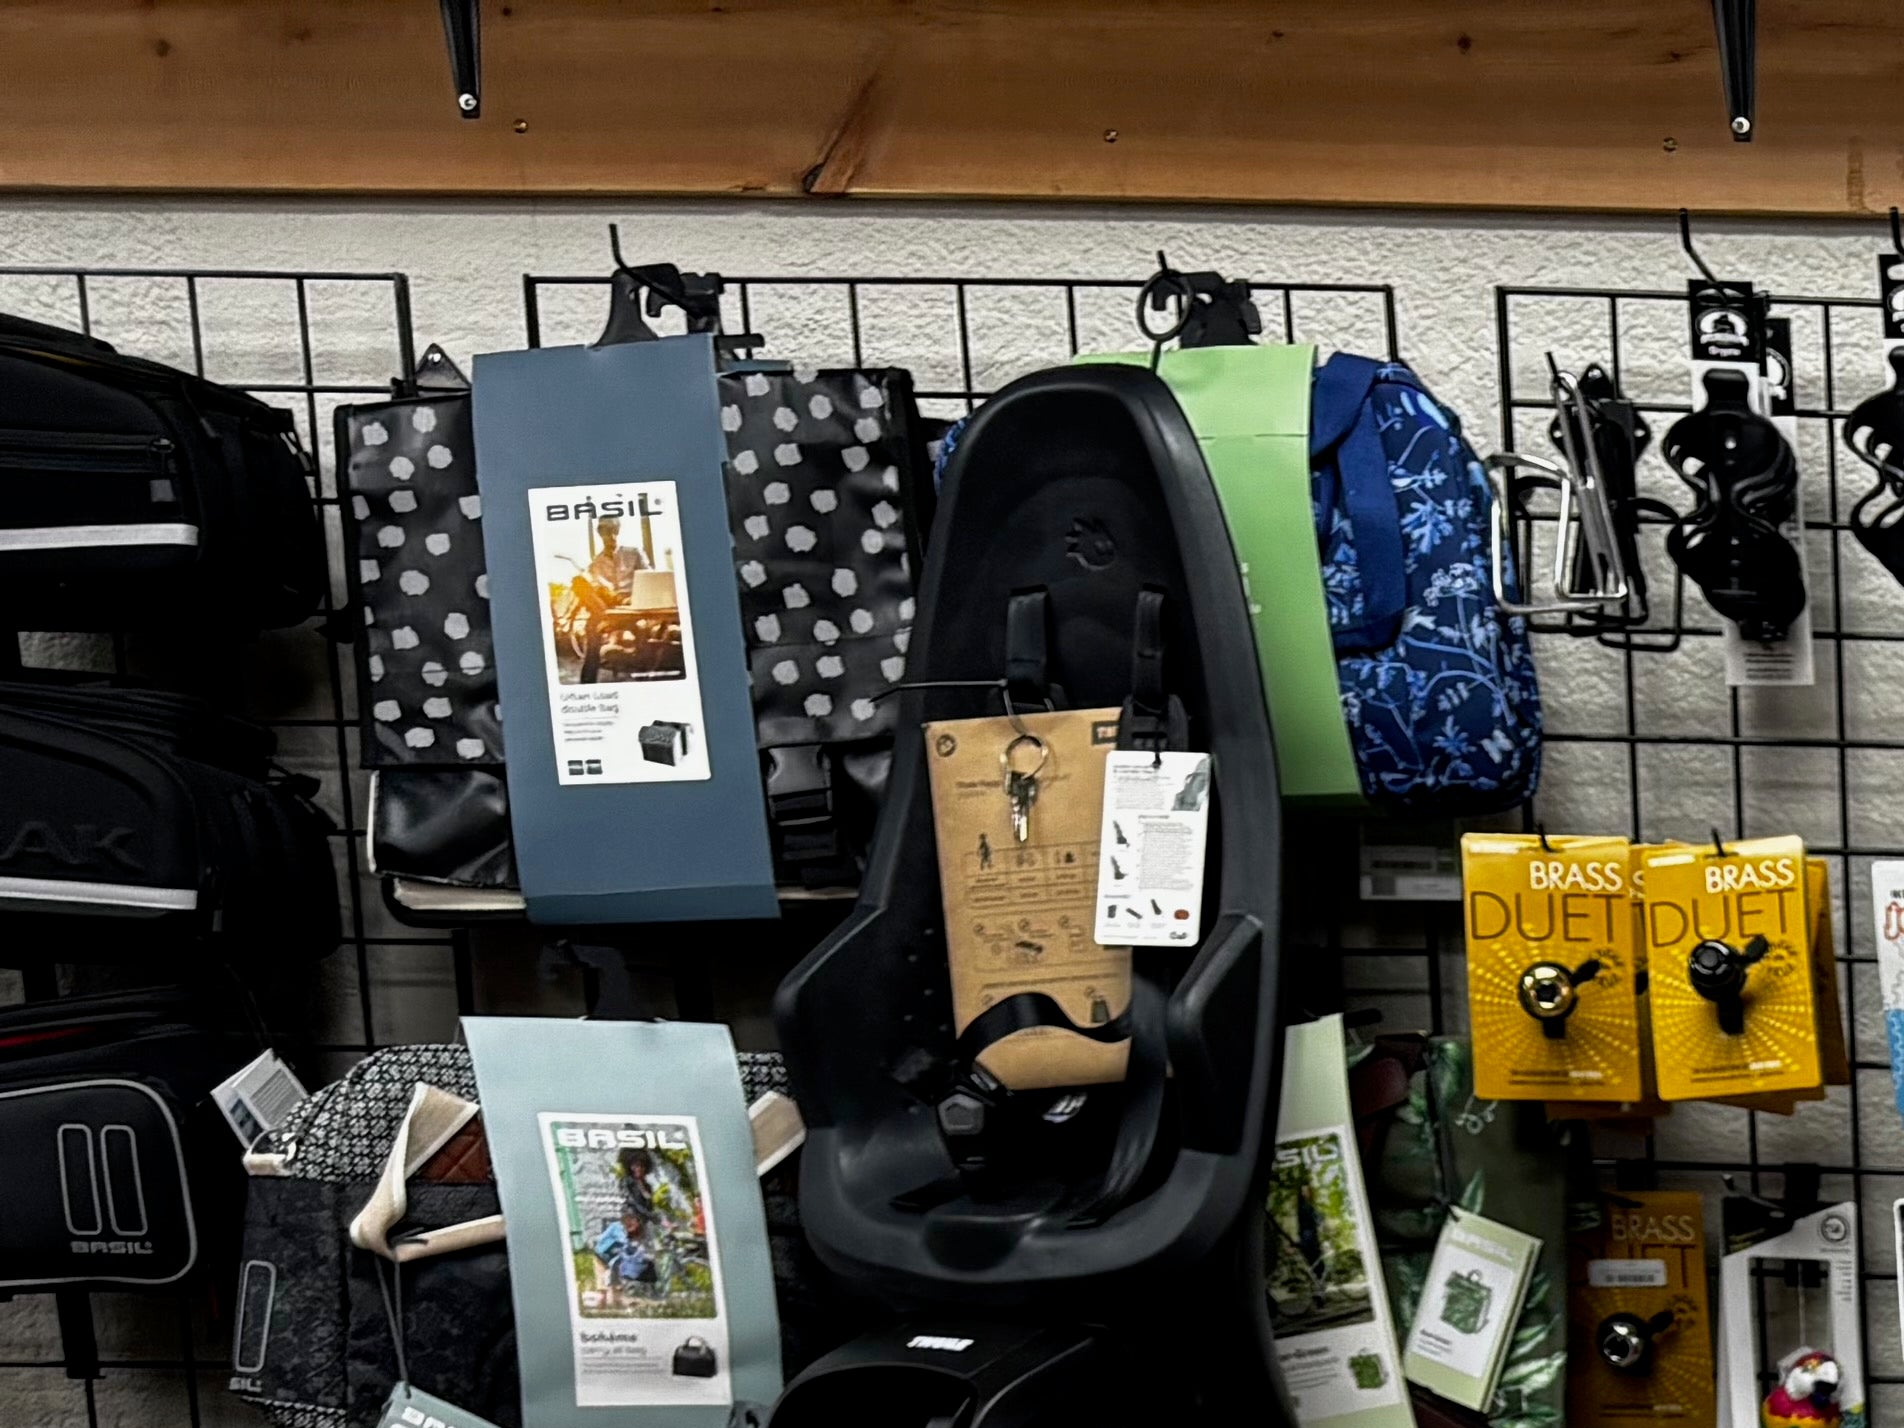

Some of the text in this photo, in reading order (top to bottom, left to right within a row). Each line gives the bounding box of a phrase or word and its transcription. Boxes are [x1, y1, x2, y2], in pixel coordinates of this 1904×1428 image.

[546, 499, 664, 521] BASIL
[1529, 860, 1624, 892] BRASS
[1704, 857, 1795, 894] BRASS
[1470, 890, 1625, 943] DUET
[1650, 886, 1797, 948] DUET
[557, 1127, 688, 1150] BASIL
[1612, 1212, 1696, 1243] BRASS
[71, 1240, 154, 1255] BASIL
